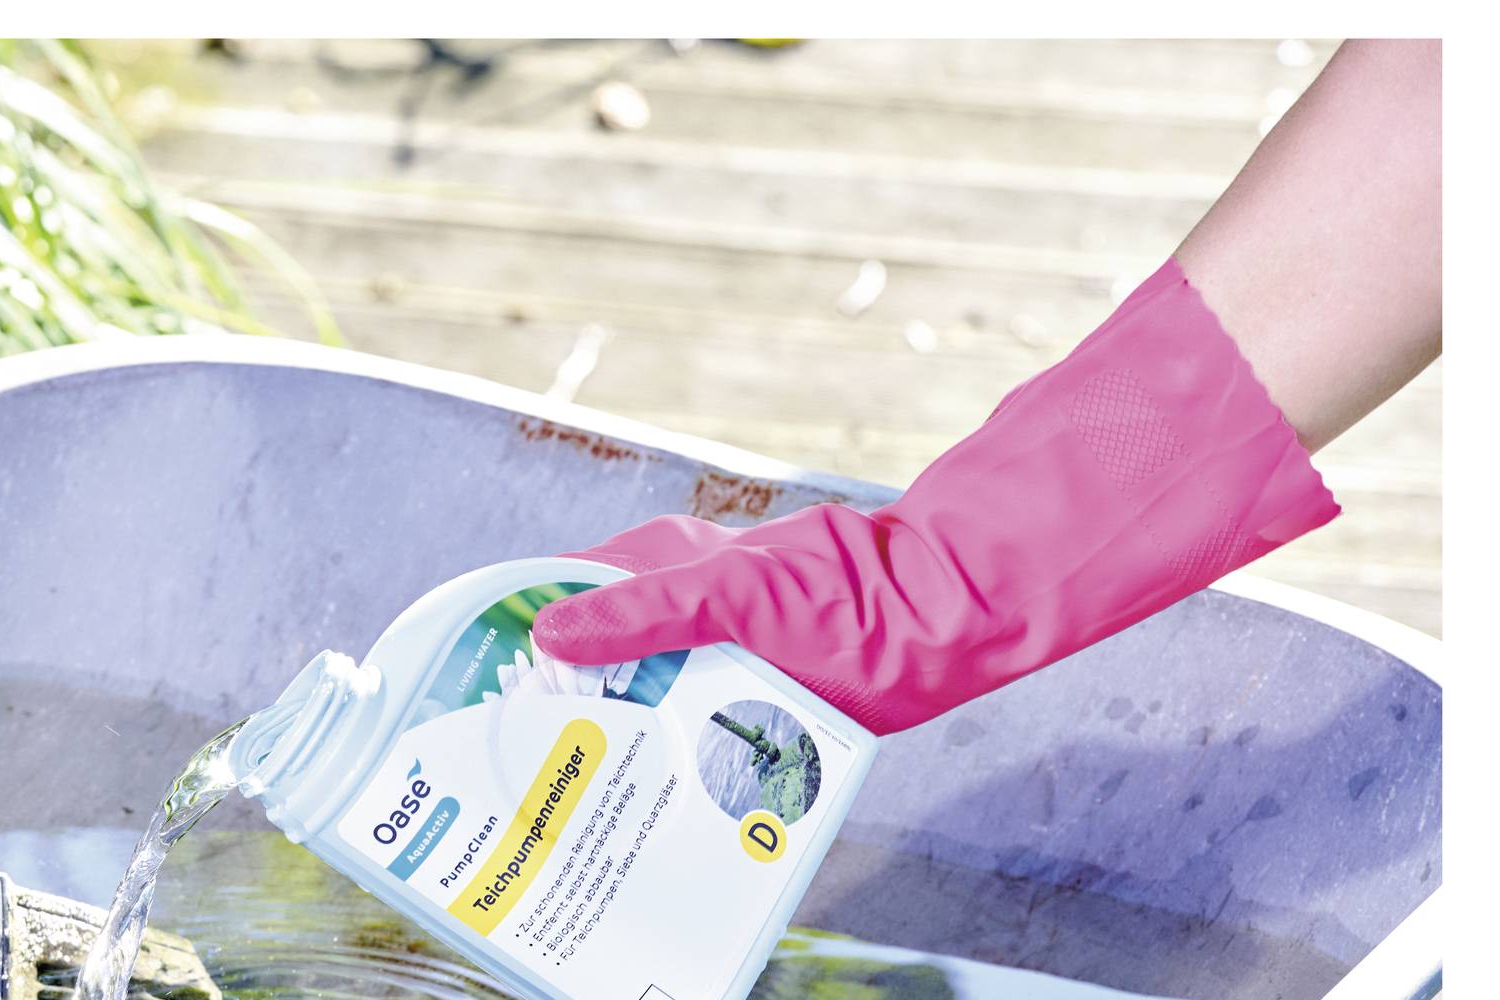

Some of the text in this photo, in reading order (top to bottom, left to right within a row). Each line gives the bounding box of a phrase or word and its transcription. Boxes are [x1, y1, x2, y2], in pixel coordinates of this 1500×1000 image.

[456, 627, 498, 693] LIVING WATER
[372, 779, 432, 845] Oase
[406, 810, 449, 864] AquaActiv
[439, 815, 498, 889] PumpClean
[472, 745, 586, 912] Teichpumpenreiniger
[518, 729, 647, 934] Zur schonenden Reinigung von Teichtechnik
[747, 822, 779, 854] D
[532, 782, 637, 942] Entfernt selbst hartnäckige Beläge
[546, 855, 614, 952] Biologisch abbaubar
[559, 773, 678, 961] Für Teichpumpen, Siebe und Quarzgläser
